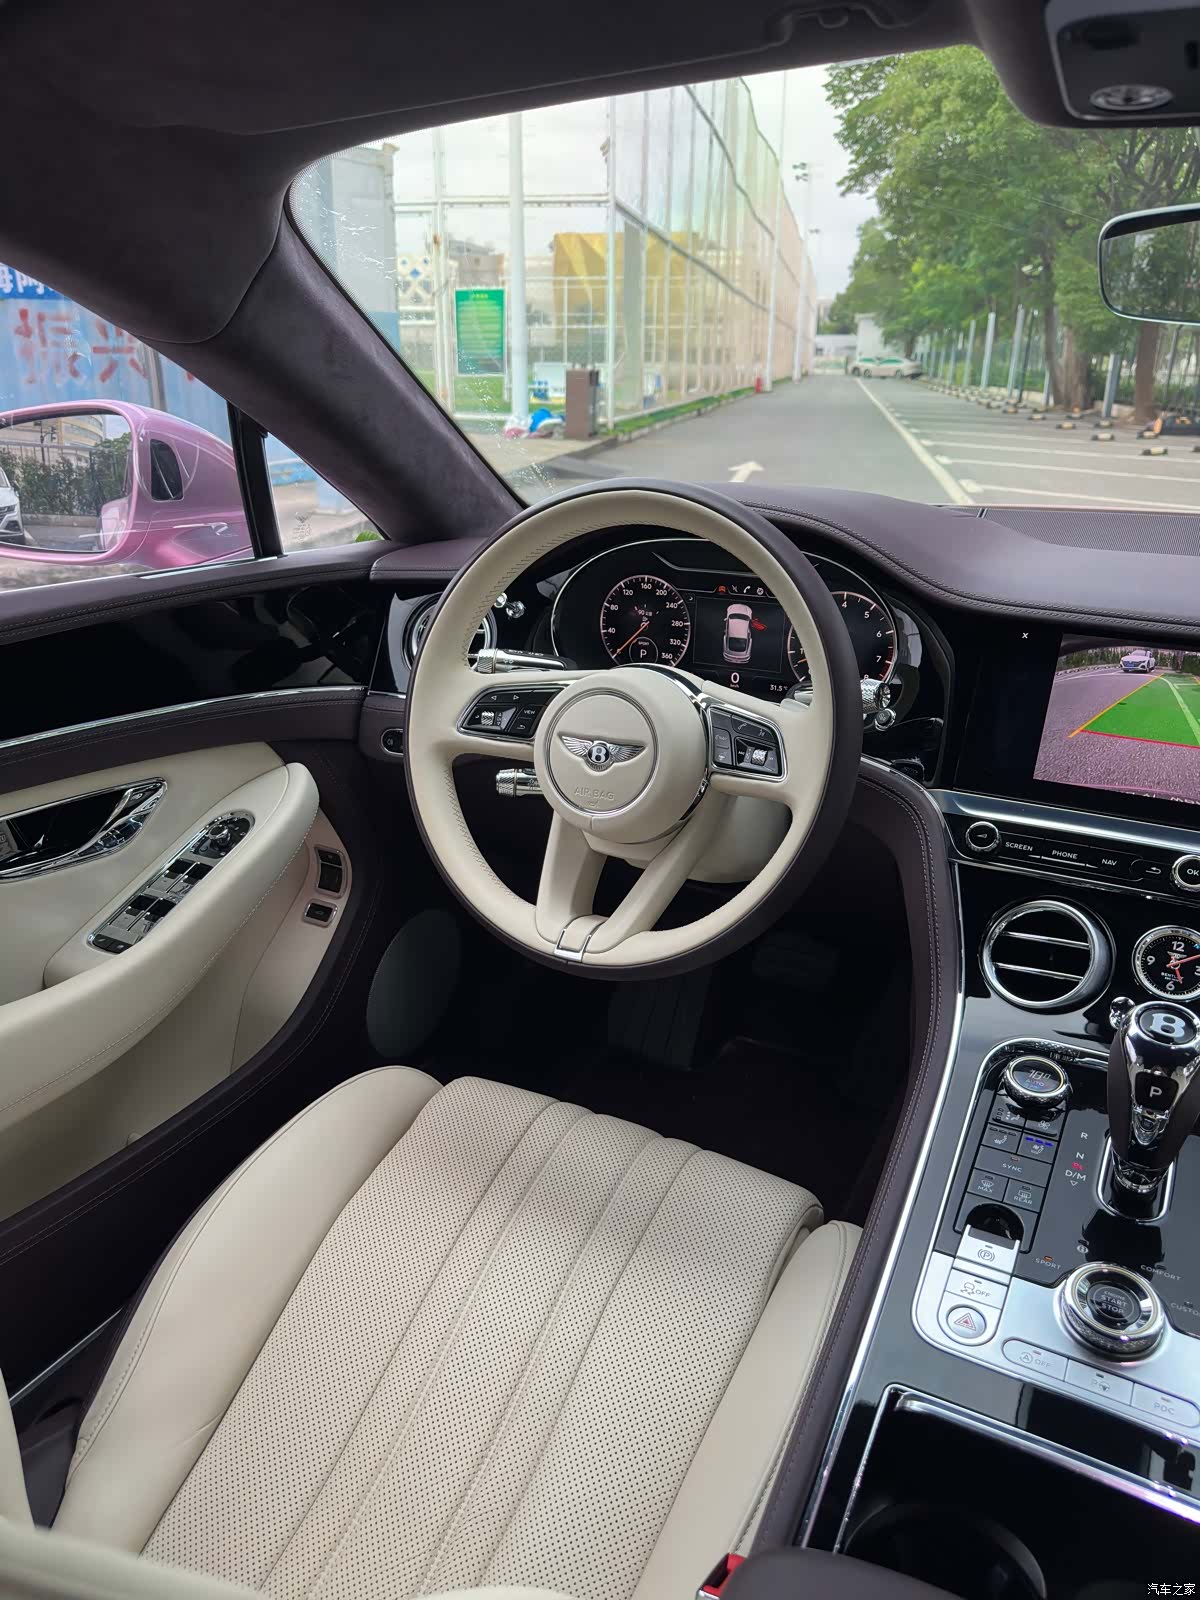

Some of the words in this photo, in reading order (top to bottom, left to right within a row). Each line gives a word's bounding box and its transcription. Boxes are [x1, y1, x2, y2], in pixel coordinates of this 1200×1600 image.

[864, 611, 870, 619] 5
[640, 649, 647, 658] P
[661, 652, 673, 660] 360
[876, 655, 882, 663] 7
[731, 672, 740, 684] 0
[592, 788, 615, 801] BAG
[1005, 841, 1033, 852] SCREEN
[1052, 850, 1079, 860] PHONE
[1101, 858, 1118, 867] NAV
[1187, 868, 1200, 877] OK
[1171, 940, 1185, 952] 12
[1146, 955, 1156, 966] 9
[1166, 980, 1175, 991] 6
[1149, 1012, 1186, 1038] B
[1149, 1086, 1162, 1098] P
[1080, 1132, 1088, 1140] R
[1075, 1152, 1085, 1160] N
[1002, 1162, 1023, 1173] SYNC
[1065, 1169, 1087, 1182] D/M
[977, 1185, 993, 1194] MAX
[1013, 1195, 1033, 1205] REAR
[1035, 1258, 1061, 1271] SPORT
[1140, 1264, 1181, 1281] COMFORT
[975, 1289, 991, 1298] OFF
[1100, 1294, 1128, 1307] START
[1101, 1303, 1124, 1314] STOP
[1034, 1358, 1051, 1368] OFF
[1154, 1402, 1175, 1416] PDC
